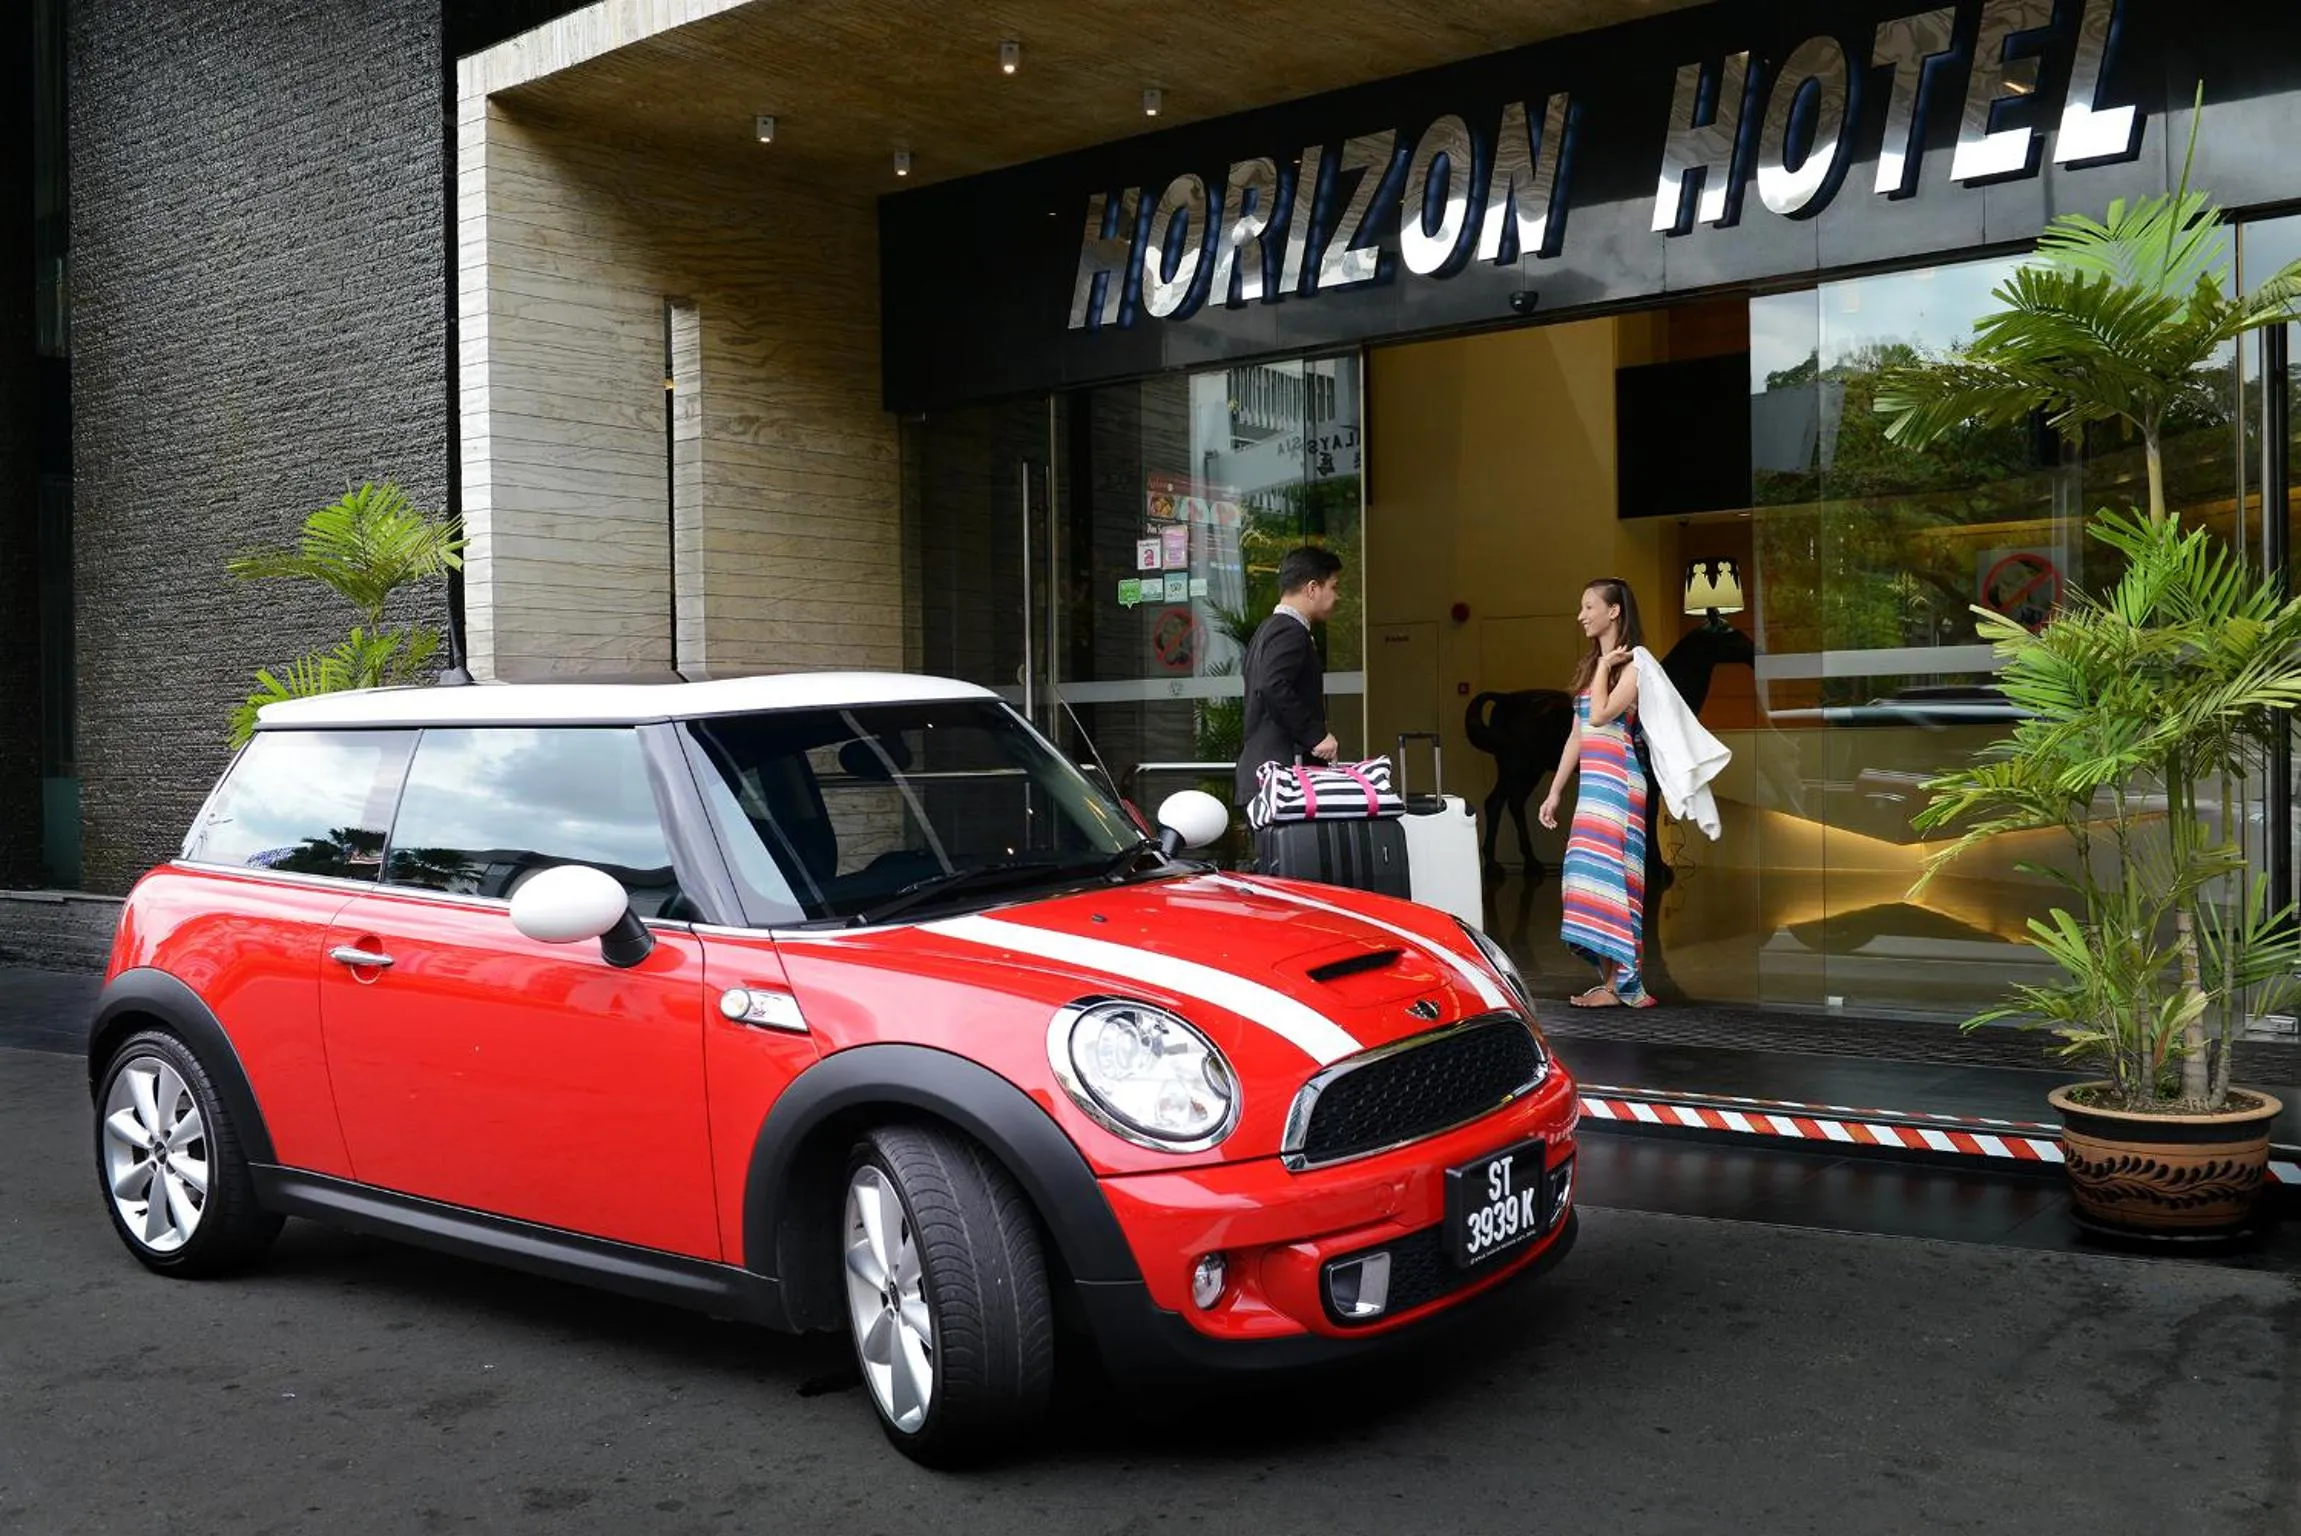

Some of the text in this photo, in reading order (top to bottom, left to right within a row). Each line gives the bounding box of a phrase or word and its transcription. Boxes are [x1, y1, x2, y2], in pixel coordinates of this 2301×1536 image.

[1068, 0, 2142, 330] HORIZON HOTEL
[1488, 1155, 1513, 1201] ST
[1467, 1195, 1519, 1254] 3939
[1522, 1187, 1535, 1229] K
